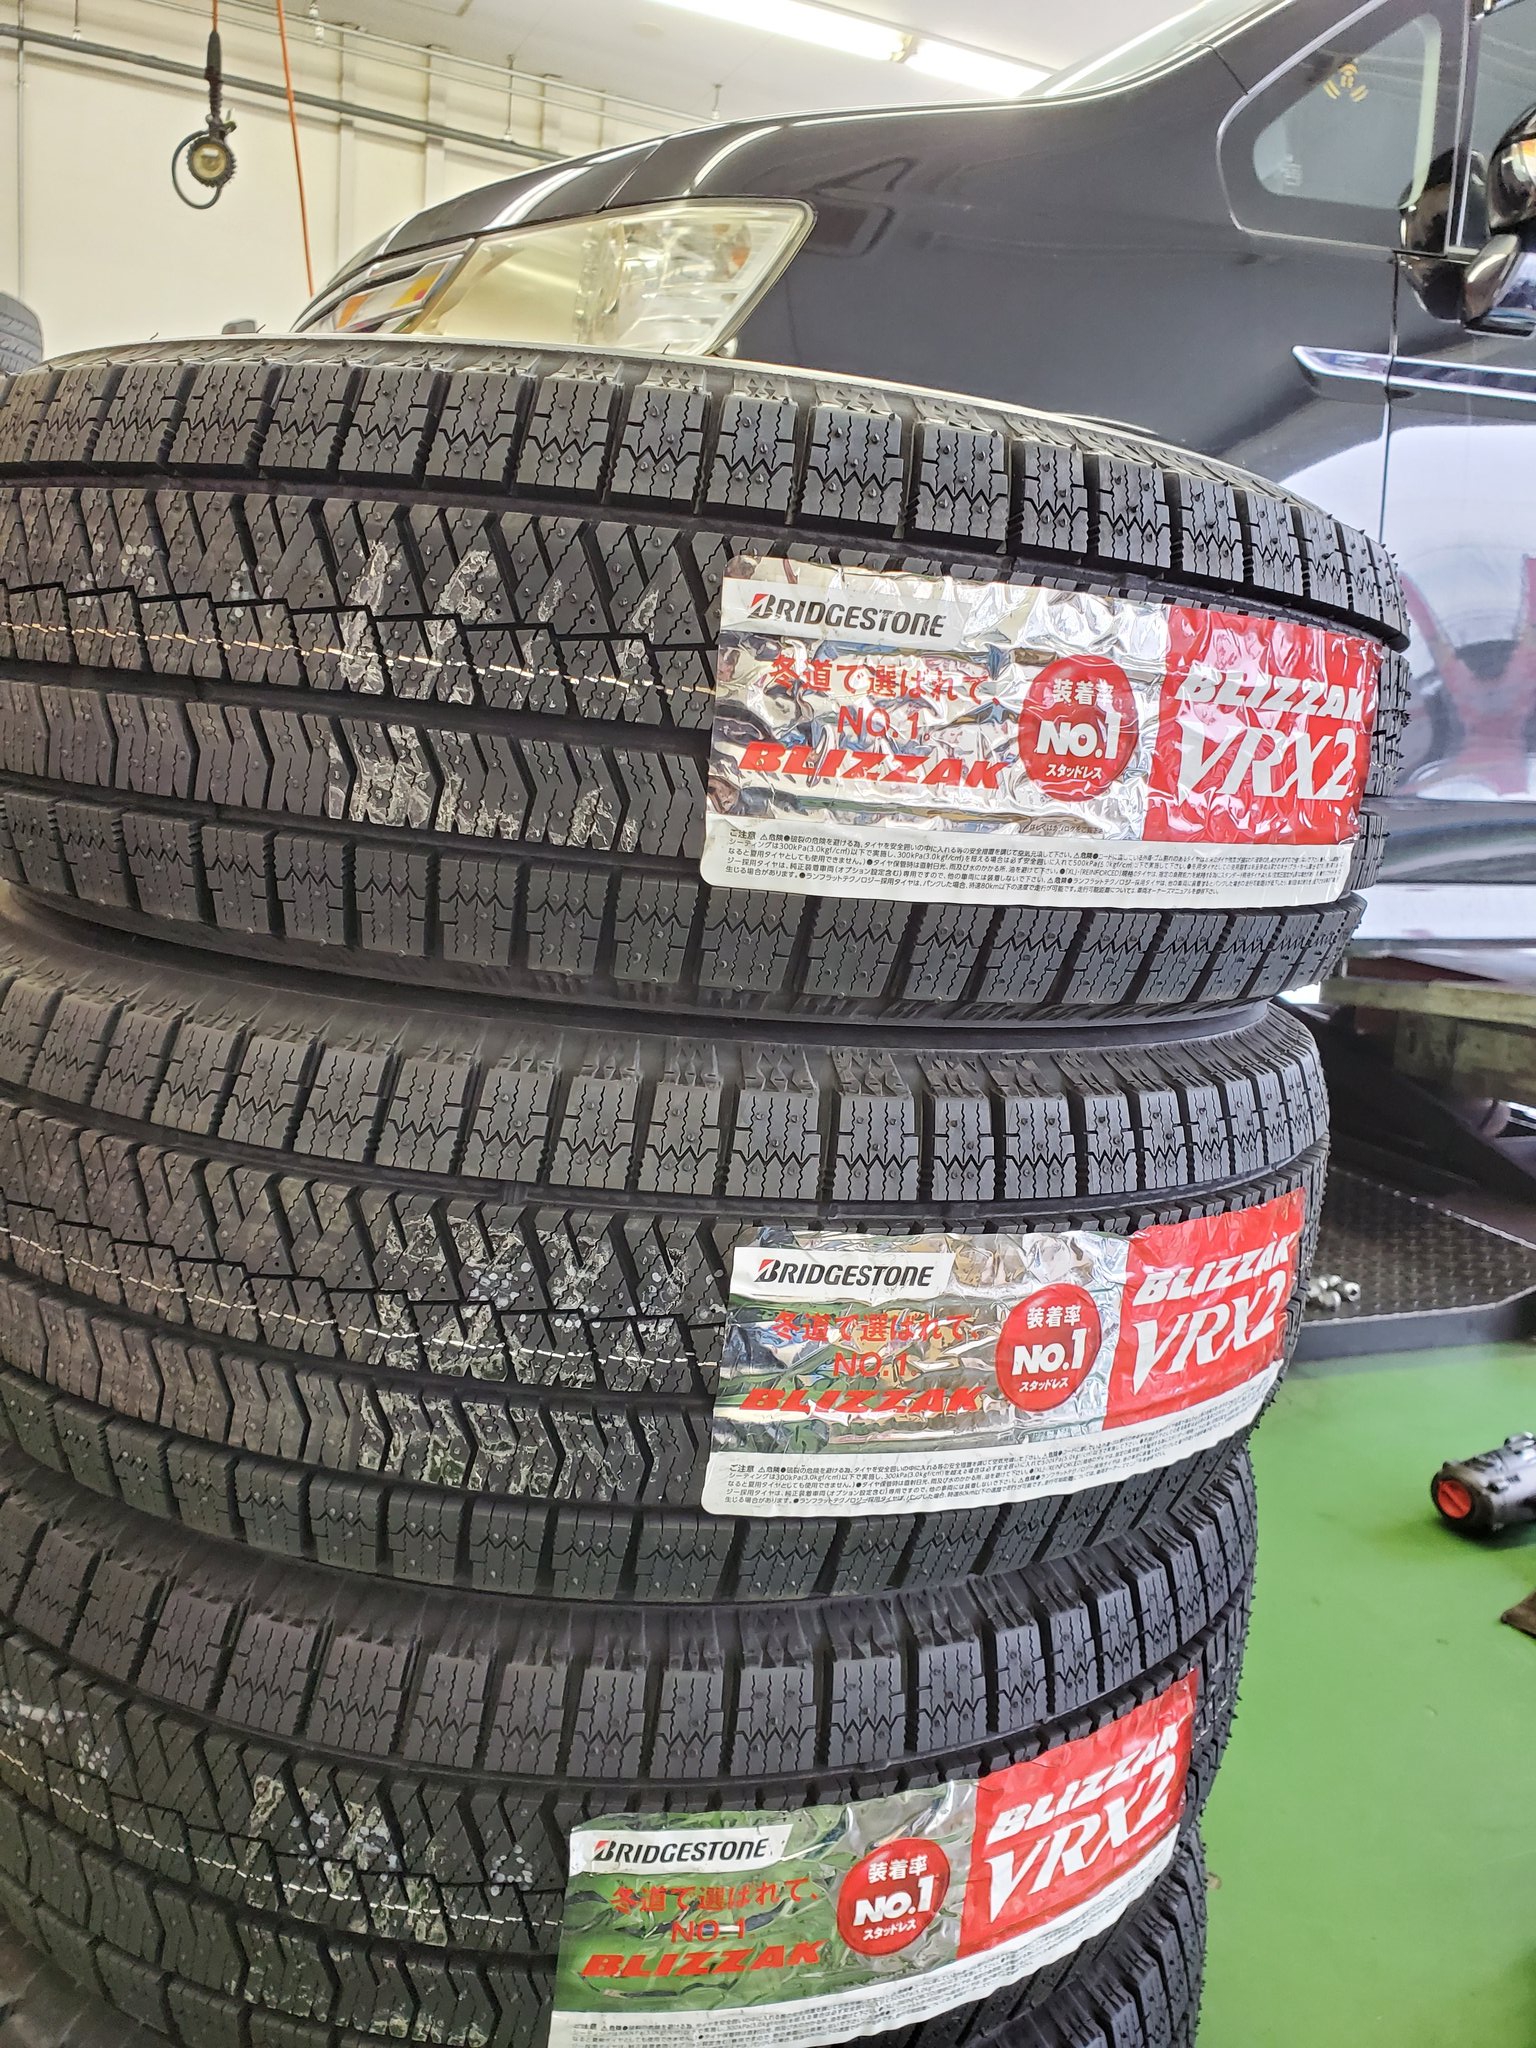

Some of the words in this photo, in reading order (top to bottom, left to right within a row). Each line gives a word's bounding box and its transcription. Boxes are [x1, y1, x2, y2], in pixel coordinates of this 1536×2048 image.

[747, 593, 947, 638] BRIDGESTONE
[1052, 678, 1115, 708] 装着率
[1035, 711, 1121, 760] NO.1
[739, 741, 1012, 789] BLIZZAK
[1045, 763, 1103, 780] スタッドレス
[1177, 719, 1358, 805] VRX2
[754, 1257, 934, 1288] BRIDGESTONE
[1133, 1233, 1293, 1306] BLIZZAK
[1026, 1305, 1081, 1328] 装着率
[1132, 1270, 1286, 1396] VRX2
[1012, 1329, 1088, 1376] NO.1
[739, 1386, 987, 1415] BLIZZAK
[1018, 1376, 1070, 1393] スタッドレス
[987, 1723, 1180, 1844] BLIZZAK
[592, 1838, 768, 1865] BRIDGESTONE
[984, 1753, 1177, 1922] VRX2
[867, 1856, 927, 1883] 装着率
[854, 1875, 935, 1925] NO.1
[862, 1918, 917, 1940] スタッドレス
[582, 1939, 829, 1977] BLIZZAK
